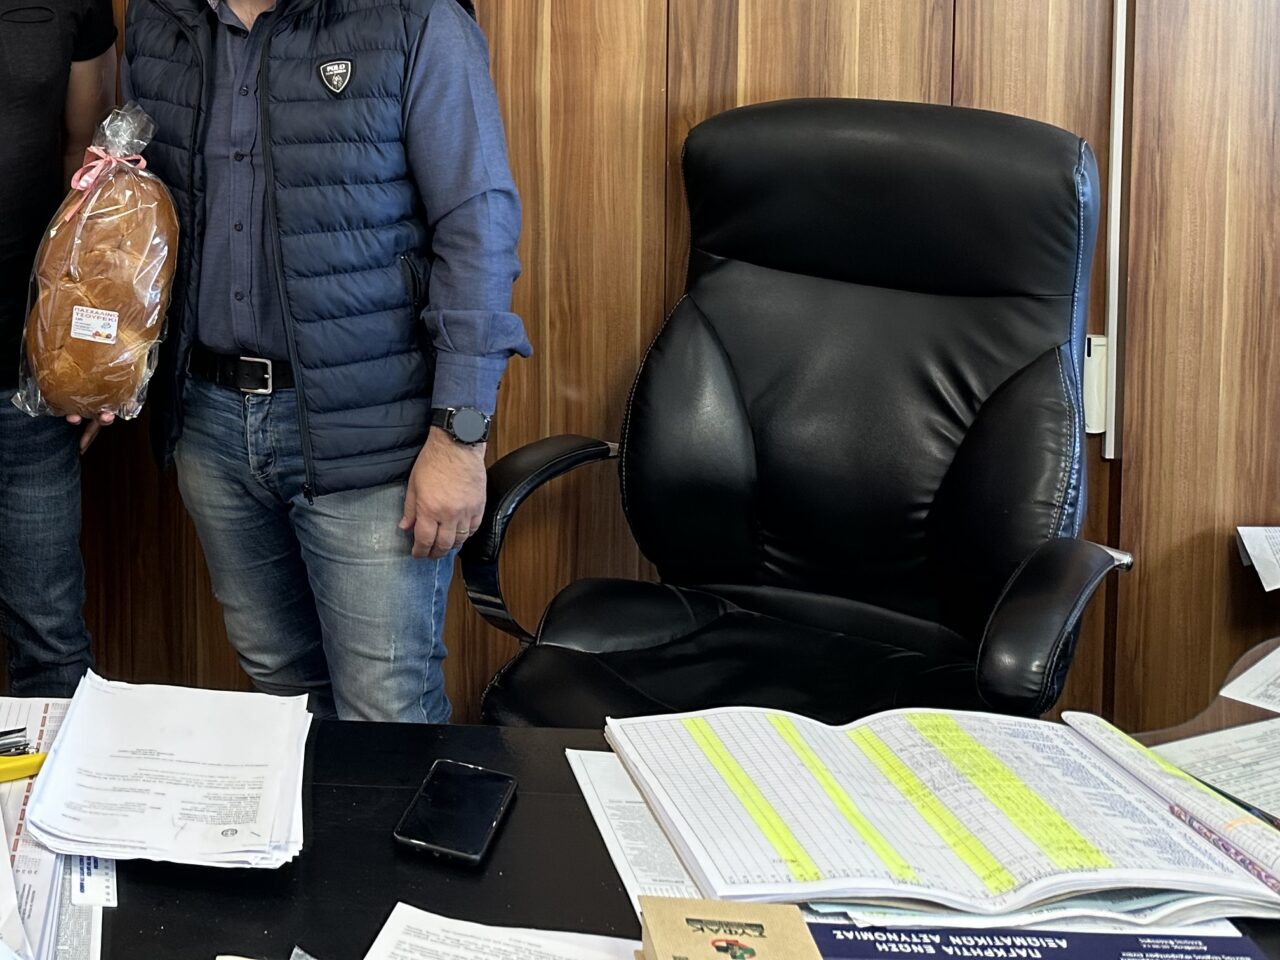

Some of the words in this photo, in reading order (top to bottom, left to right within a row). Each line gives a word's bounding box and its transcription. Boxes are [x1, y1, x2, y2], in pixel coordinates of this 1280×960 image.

[832, 929, 941, 943] ΑΣΤΥΝΟΜΙΑΣ
[948, 935, 1069, 949] ΑΞΙΩΜΑΤΙΚΩΝ
[875, 941, 936, 954] ΕΝΩΣΗ
[941, 944, 1042, 959] ΠΑΓΚΡΗΤΙΑ
